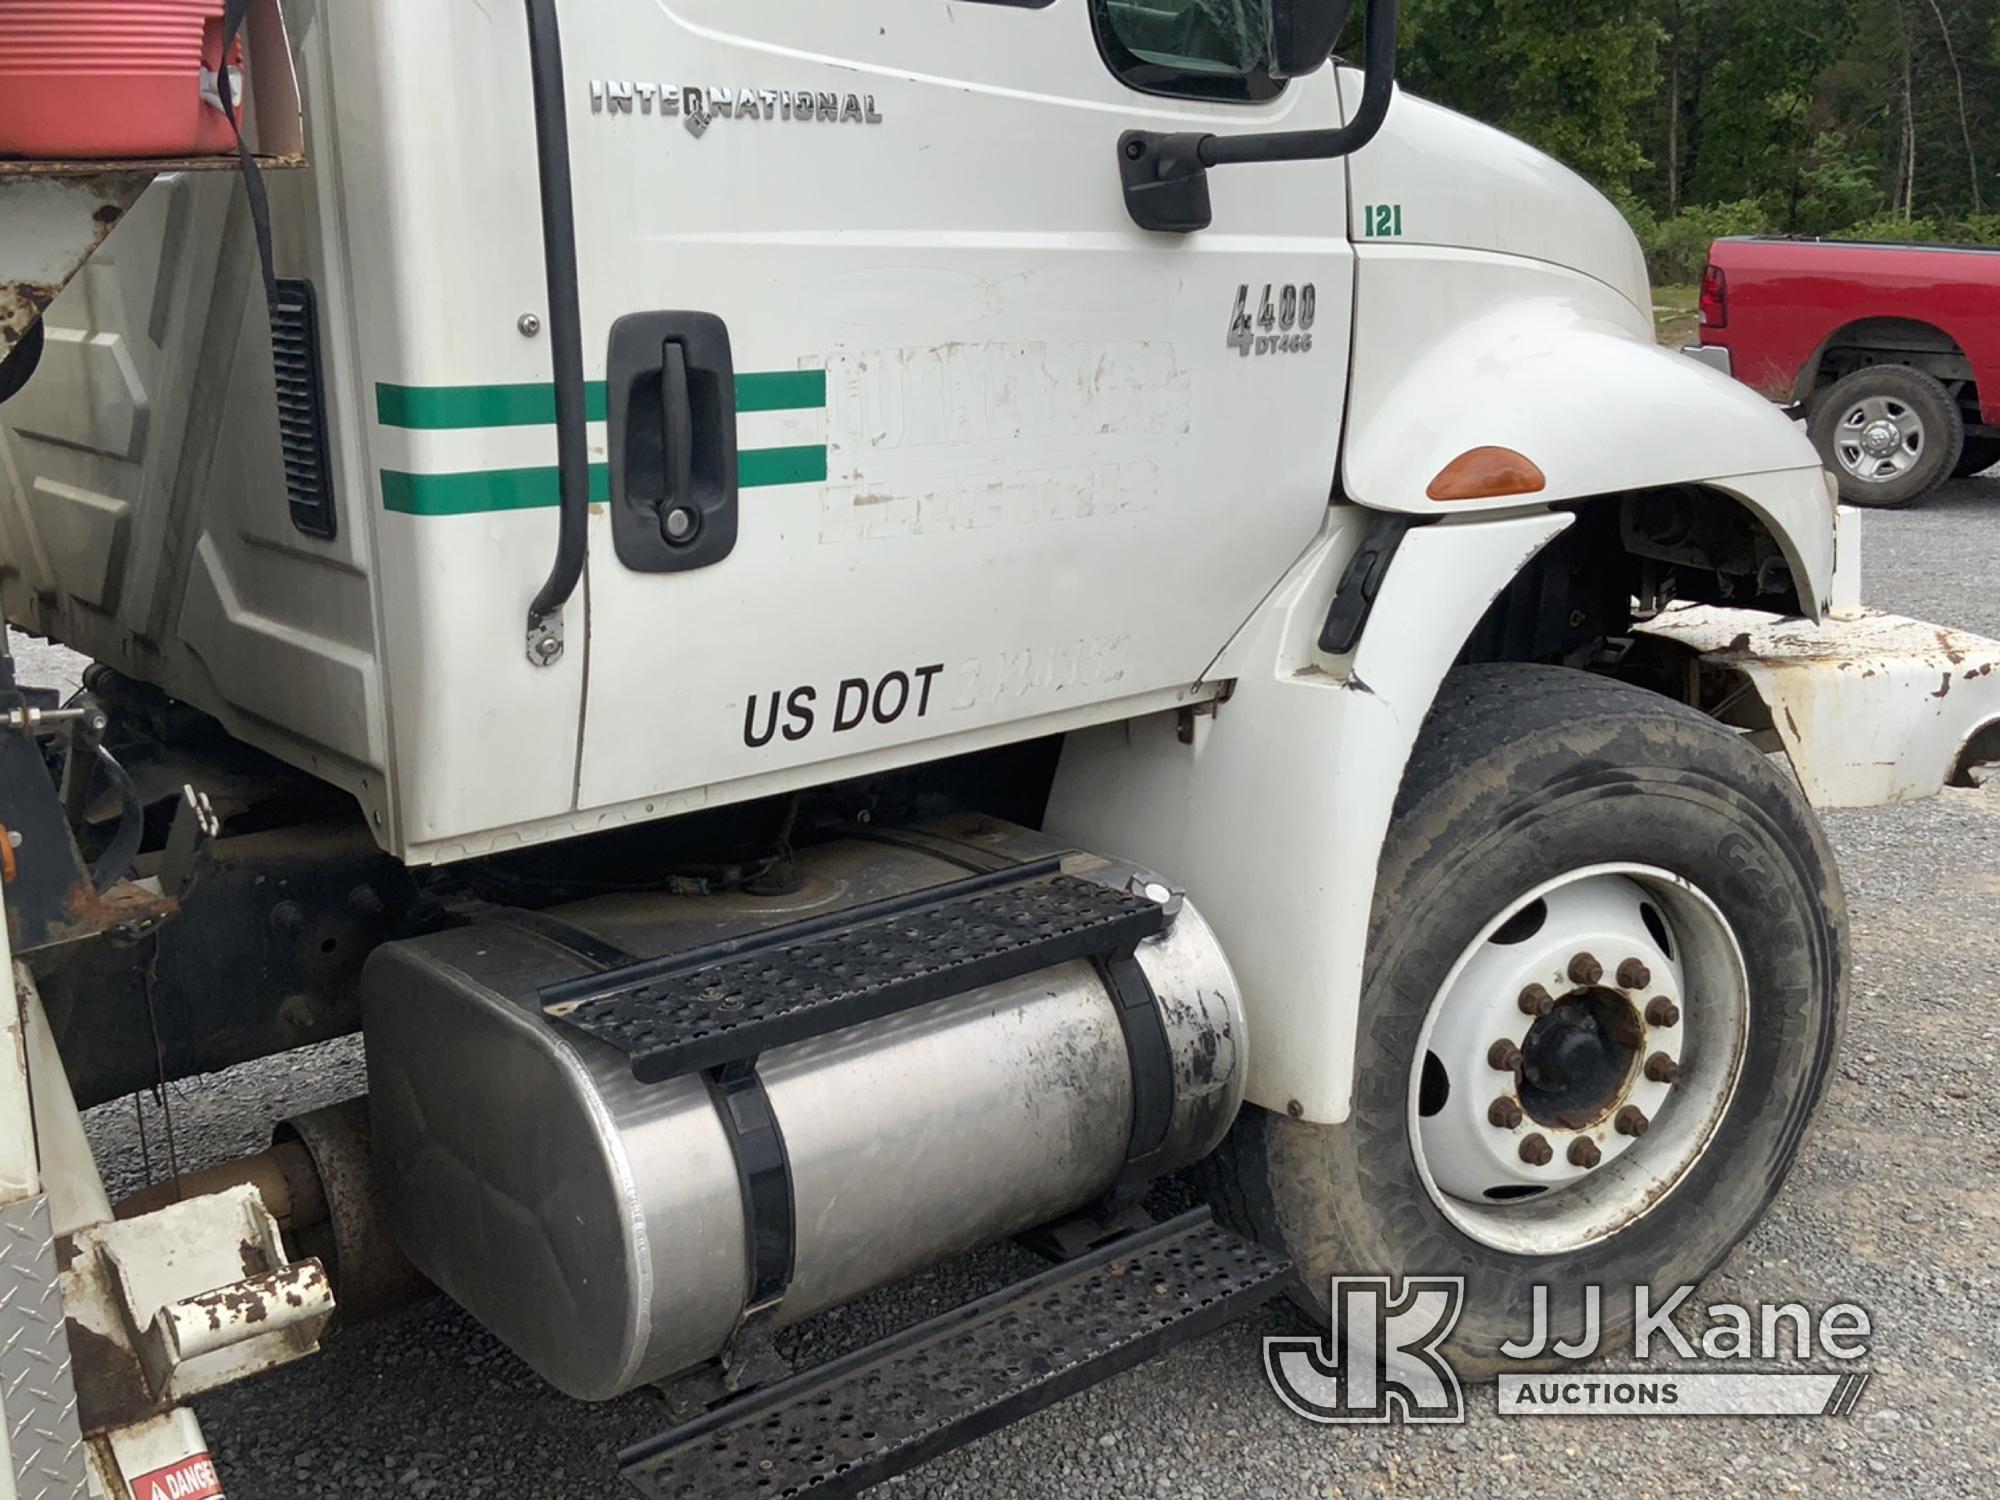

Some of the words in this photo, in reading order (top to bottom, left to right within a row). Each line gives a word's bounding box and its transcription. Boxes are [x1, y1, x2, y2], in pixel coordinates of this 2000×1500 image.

[1364, 204, 1402, 237] 121
[1227, 282, 1316, 356] 4400
[1255, 333, 1313, 355] DT466
[743, 685, 817, 748] US
[833, 663, 944, 733] DOT
